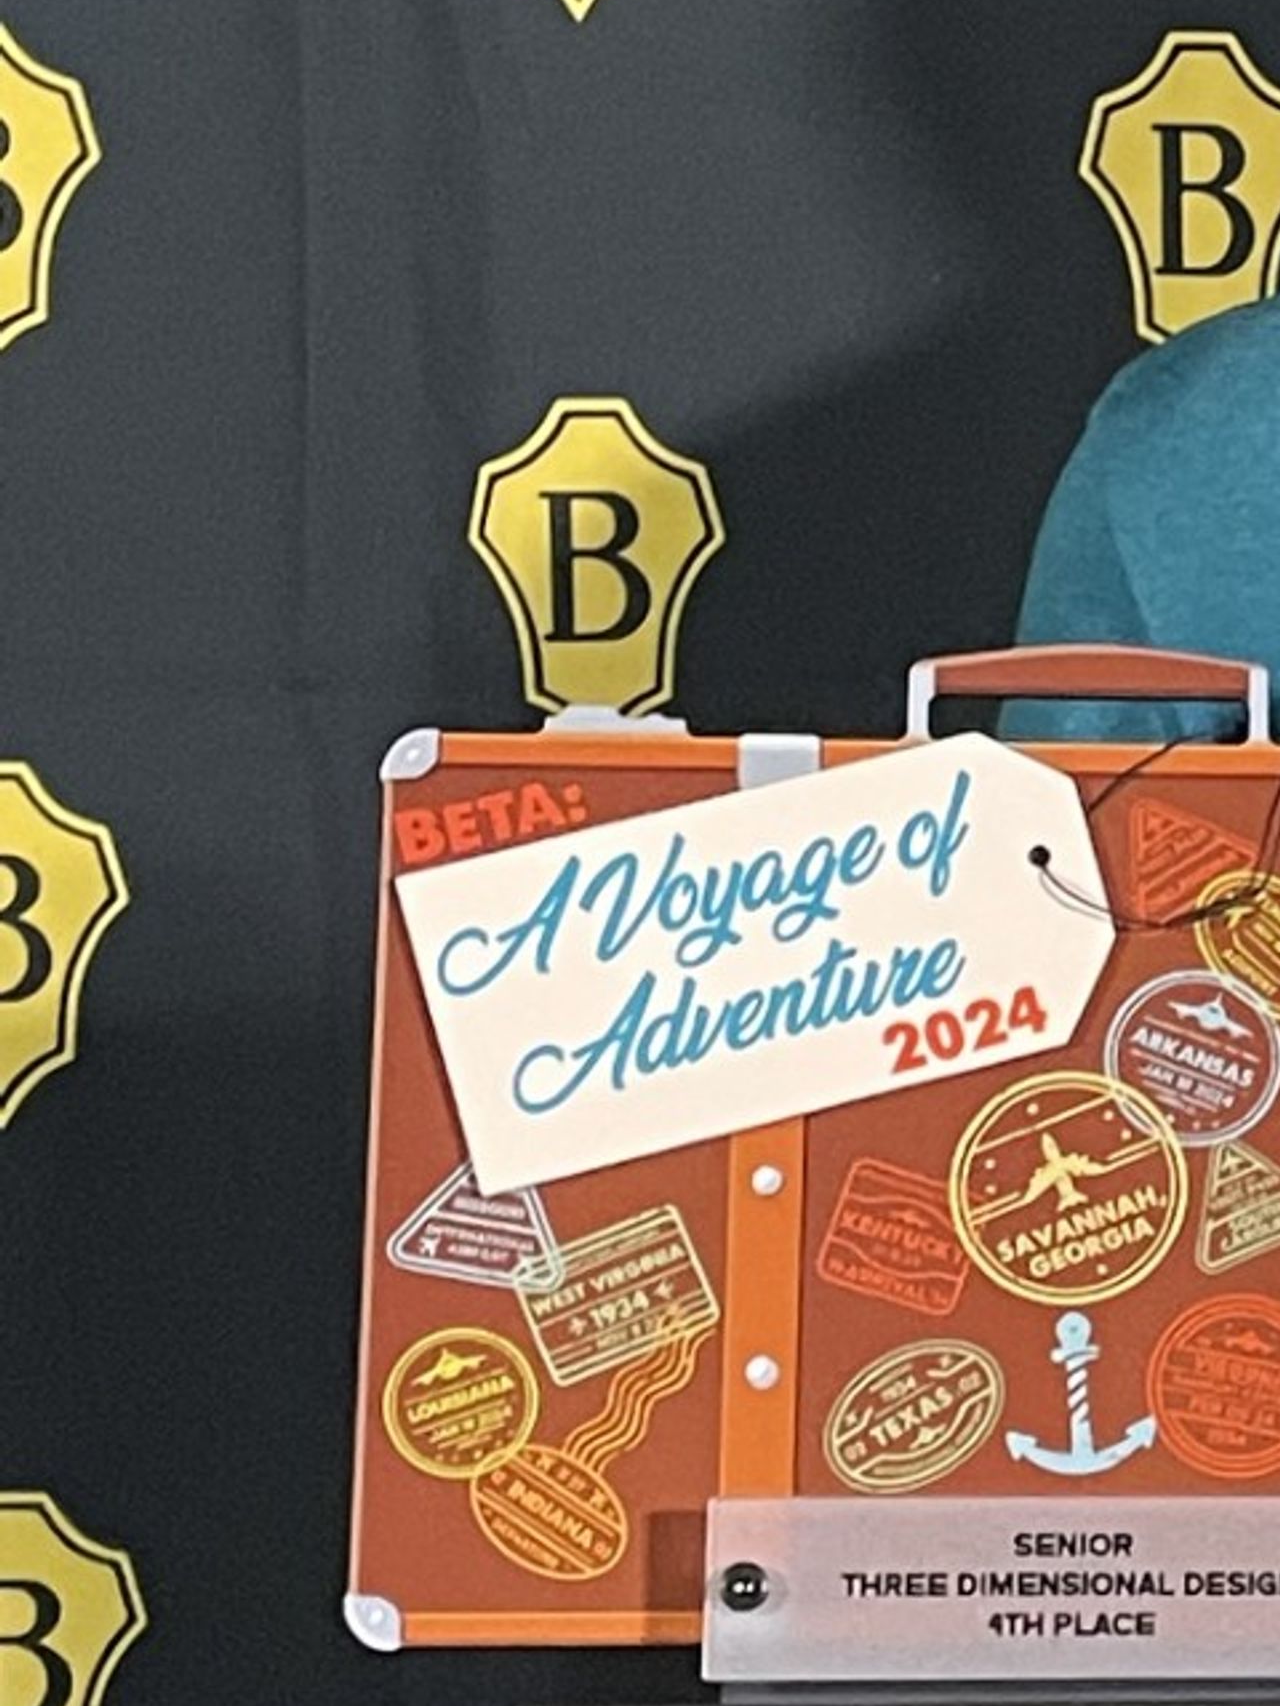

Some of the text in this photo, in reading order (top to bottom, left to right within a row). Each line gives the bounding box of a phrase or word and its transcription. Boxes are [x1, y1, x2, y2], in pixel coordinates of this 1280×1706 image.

[1152, 124, 1254, 276] B
[540, 492, 651, 642] B
[394, 782, 587, 865] BETA:
[437, 856, 581, 995] A
[579, 832, 886, 968] Voyage
[897, 770, 972, 898] of
[512, 937, 967, 1114] Adventure
[881, 985, 1049, 1075] 2024
[1130, 1026, 1255, 1088] ARKANSAS
[996, 1184, 1167, 1264] SAVANNAH,
[1028, 1215, 1156, 1278] GEORGIA
[530, 1281, 586, 1317] WEST
[588, 1242, 687, 1294] VIRGINIA
[406, 1374, 516, 1425] LOUISIANA
[868, 1385, 954, 1447] TEXAS
[506, 1477, 595, 1549] INDIANA
[1013, 1533, 1133, 1558] SENIOR
[842, 1572, 948, 1598] THREE
[956, 1572, 1174, 1598] DIMENSIONAL
[987, 1611, 1157, 1637] 4TH PLACE
